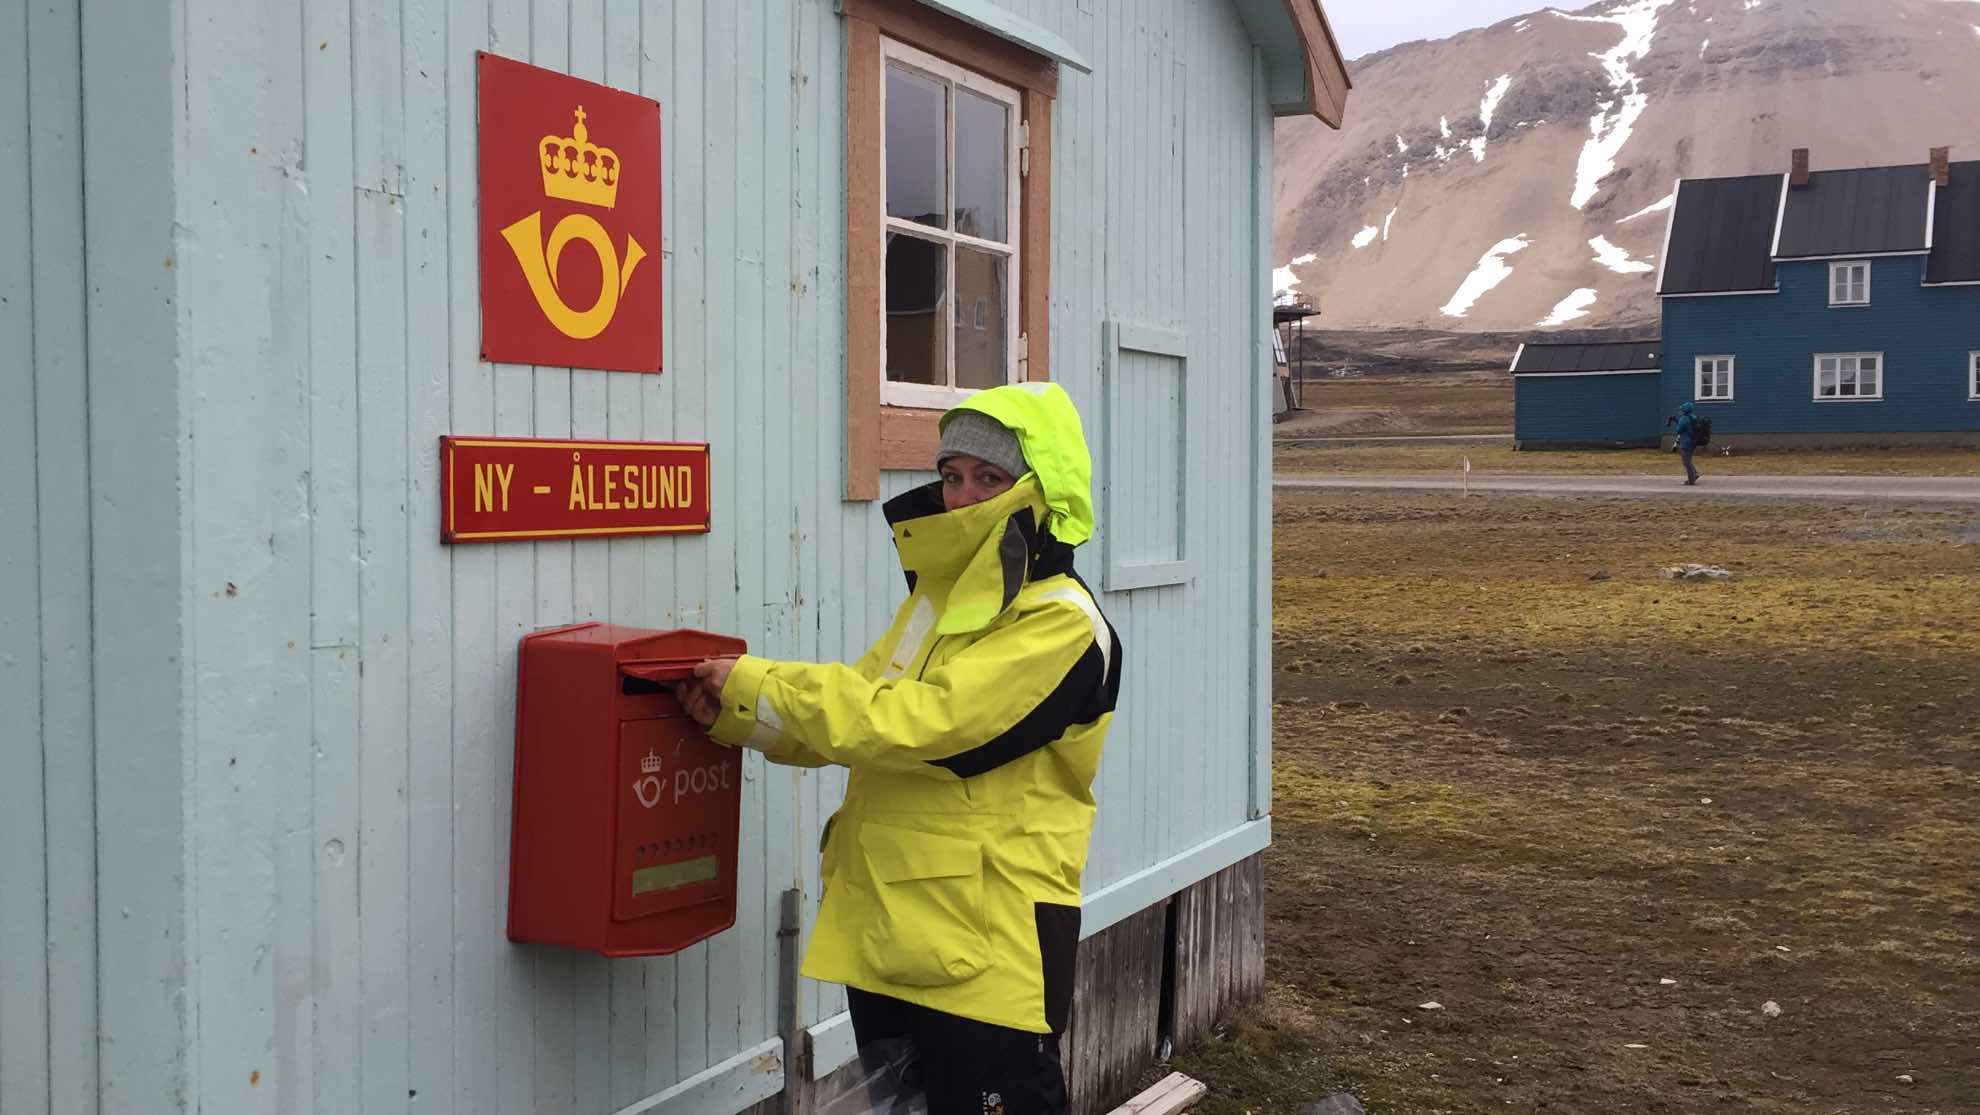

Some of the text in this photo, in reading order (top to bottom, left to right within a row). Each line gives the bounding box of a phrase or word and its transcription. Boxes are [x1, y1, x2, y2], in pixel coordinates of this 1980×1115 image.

[475, 463, 514, 513] NY
[569, 451, 692, 511] ÅLESUND
[674, 759, 731, 805] post
